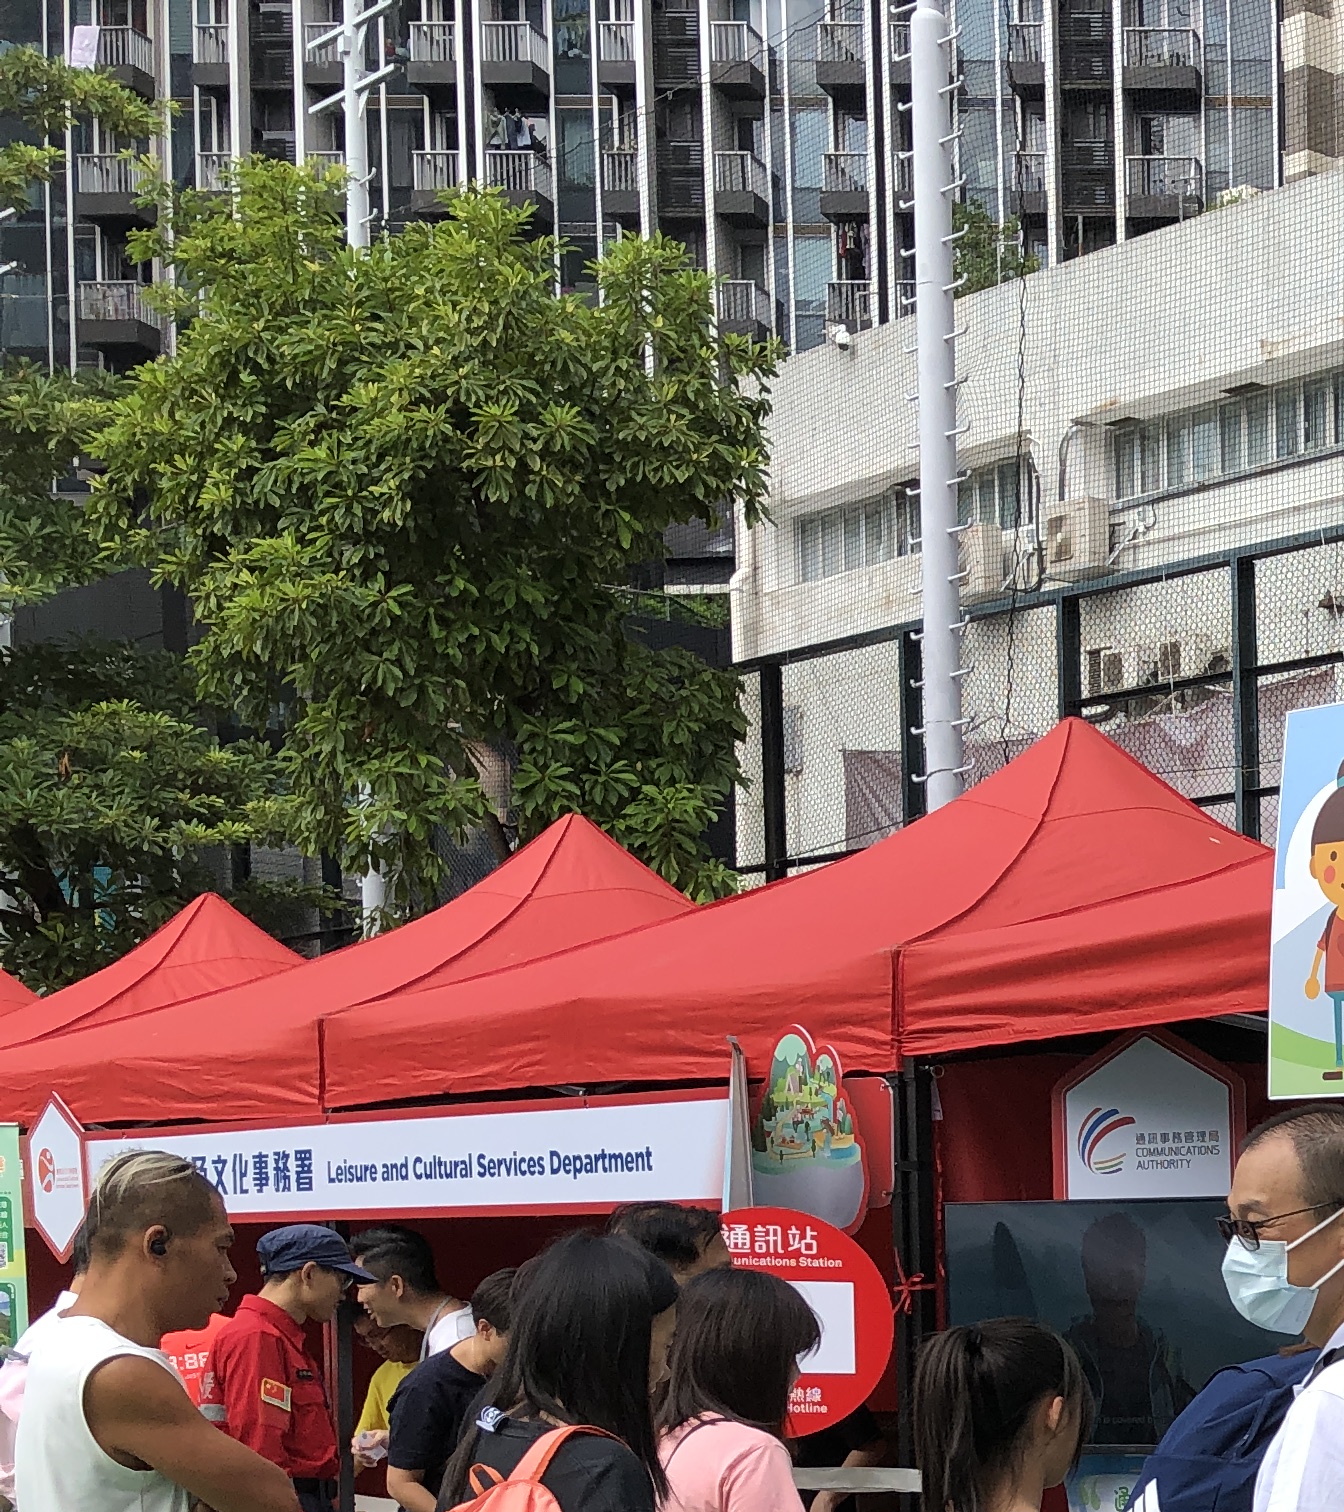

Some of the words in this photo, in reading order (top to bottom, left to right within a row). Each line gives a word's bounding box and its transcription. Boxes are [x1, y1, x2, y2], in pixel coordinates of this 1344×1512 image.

[1136, 1145, 1220, 1158] COMMUNICATIONS
[327, 1156, 379, 1184] Leisure
[381, 1157, 410, 1181] and
[413, 1153, 473, 1181] Cultural
[476, 1150, 546, 1178] Services
[549, 1146, 653, 1180] Department
[1136, 1159, 1192, 1171] AUTHORITY
[721, 1224, 819, 1255] 通訊站
[732, 1256, 797, 1267] unications
[799, 1256, 843, 1268] Station
